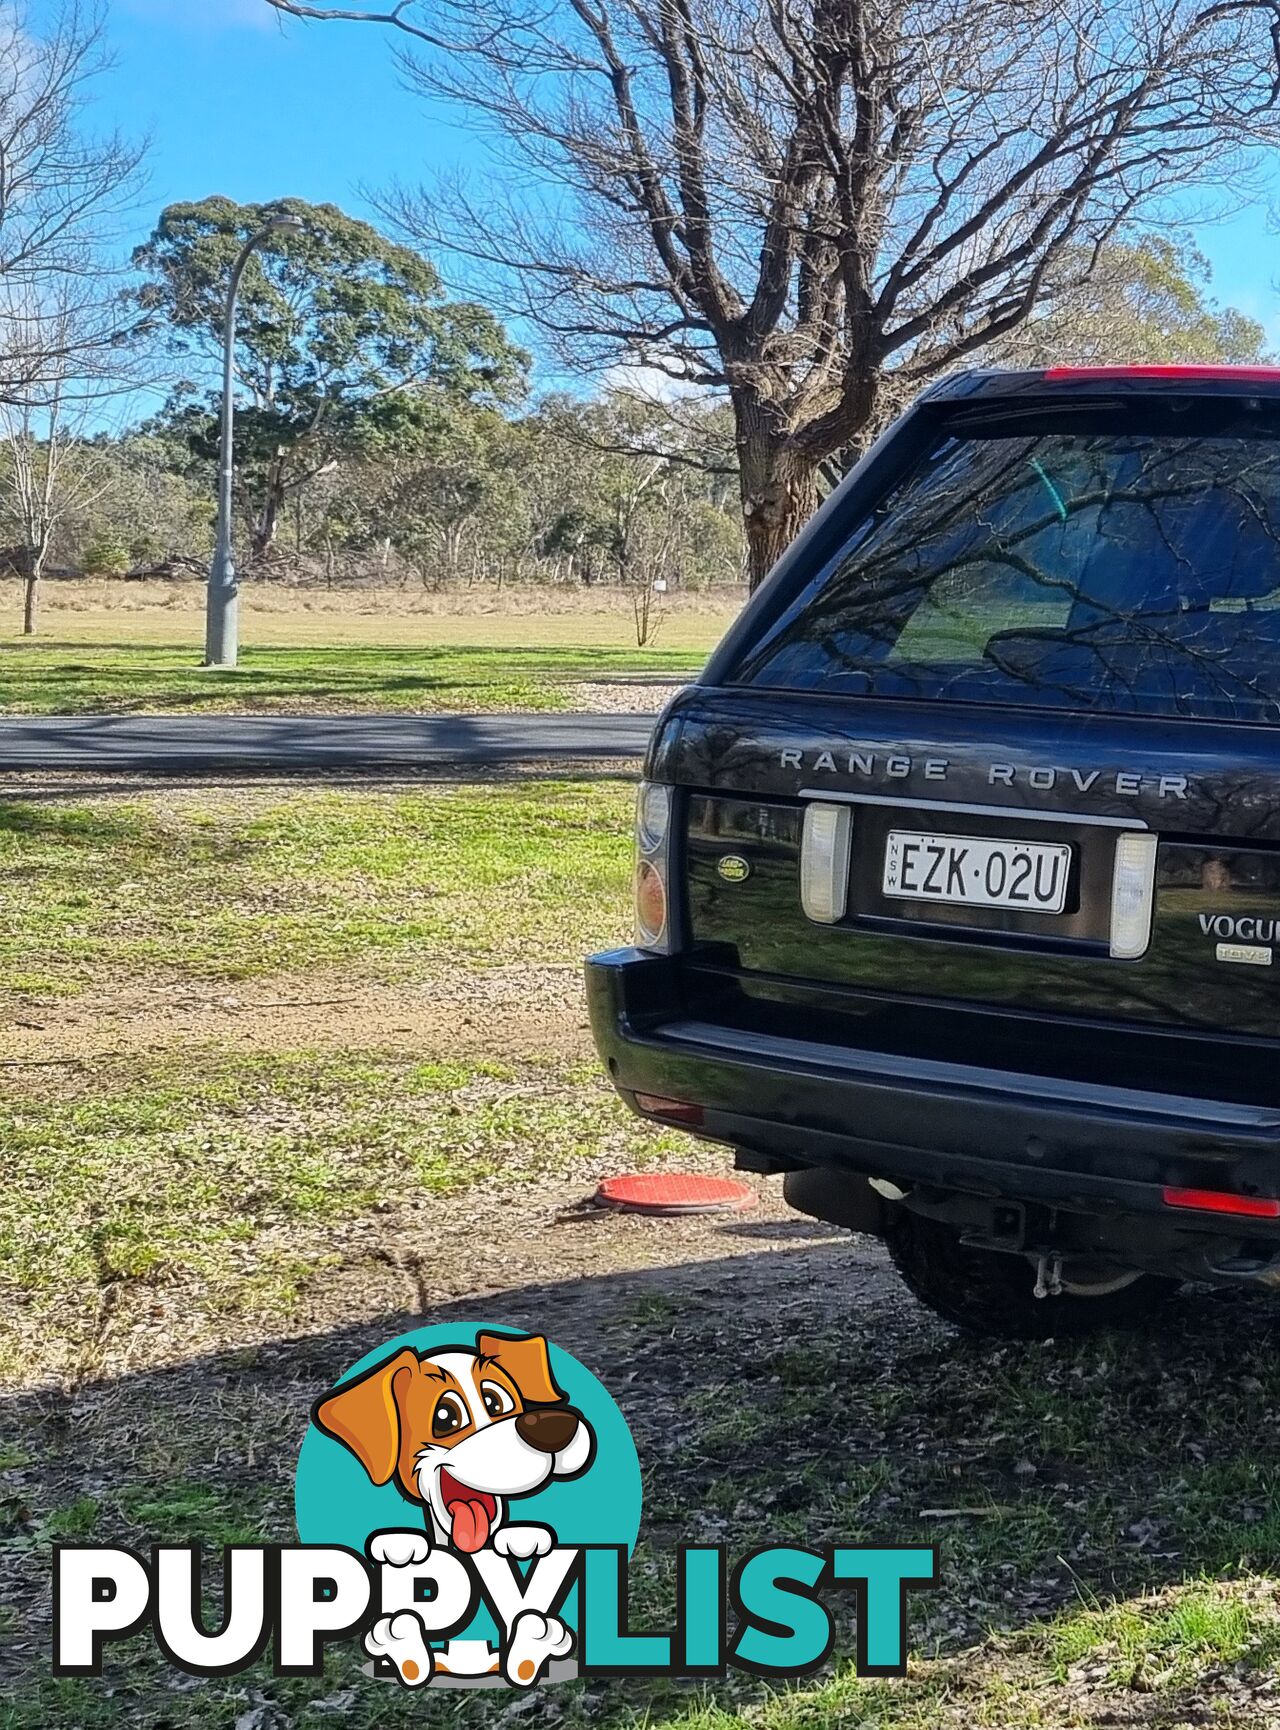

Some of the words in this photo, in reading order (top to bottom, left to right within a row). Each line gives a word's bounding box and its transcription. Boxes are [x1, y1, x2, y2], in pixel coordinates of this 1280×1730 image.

[780, 747, 950, 780] RANGE
[988, 762, 1189, 800] ROVER
[887, 844, 899, 887] NSW
